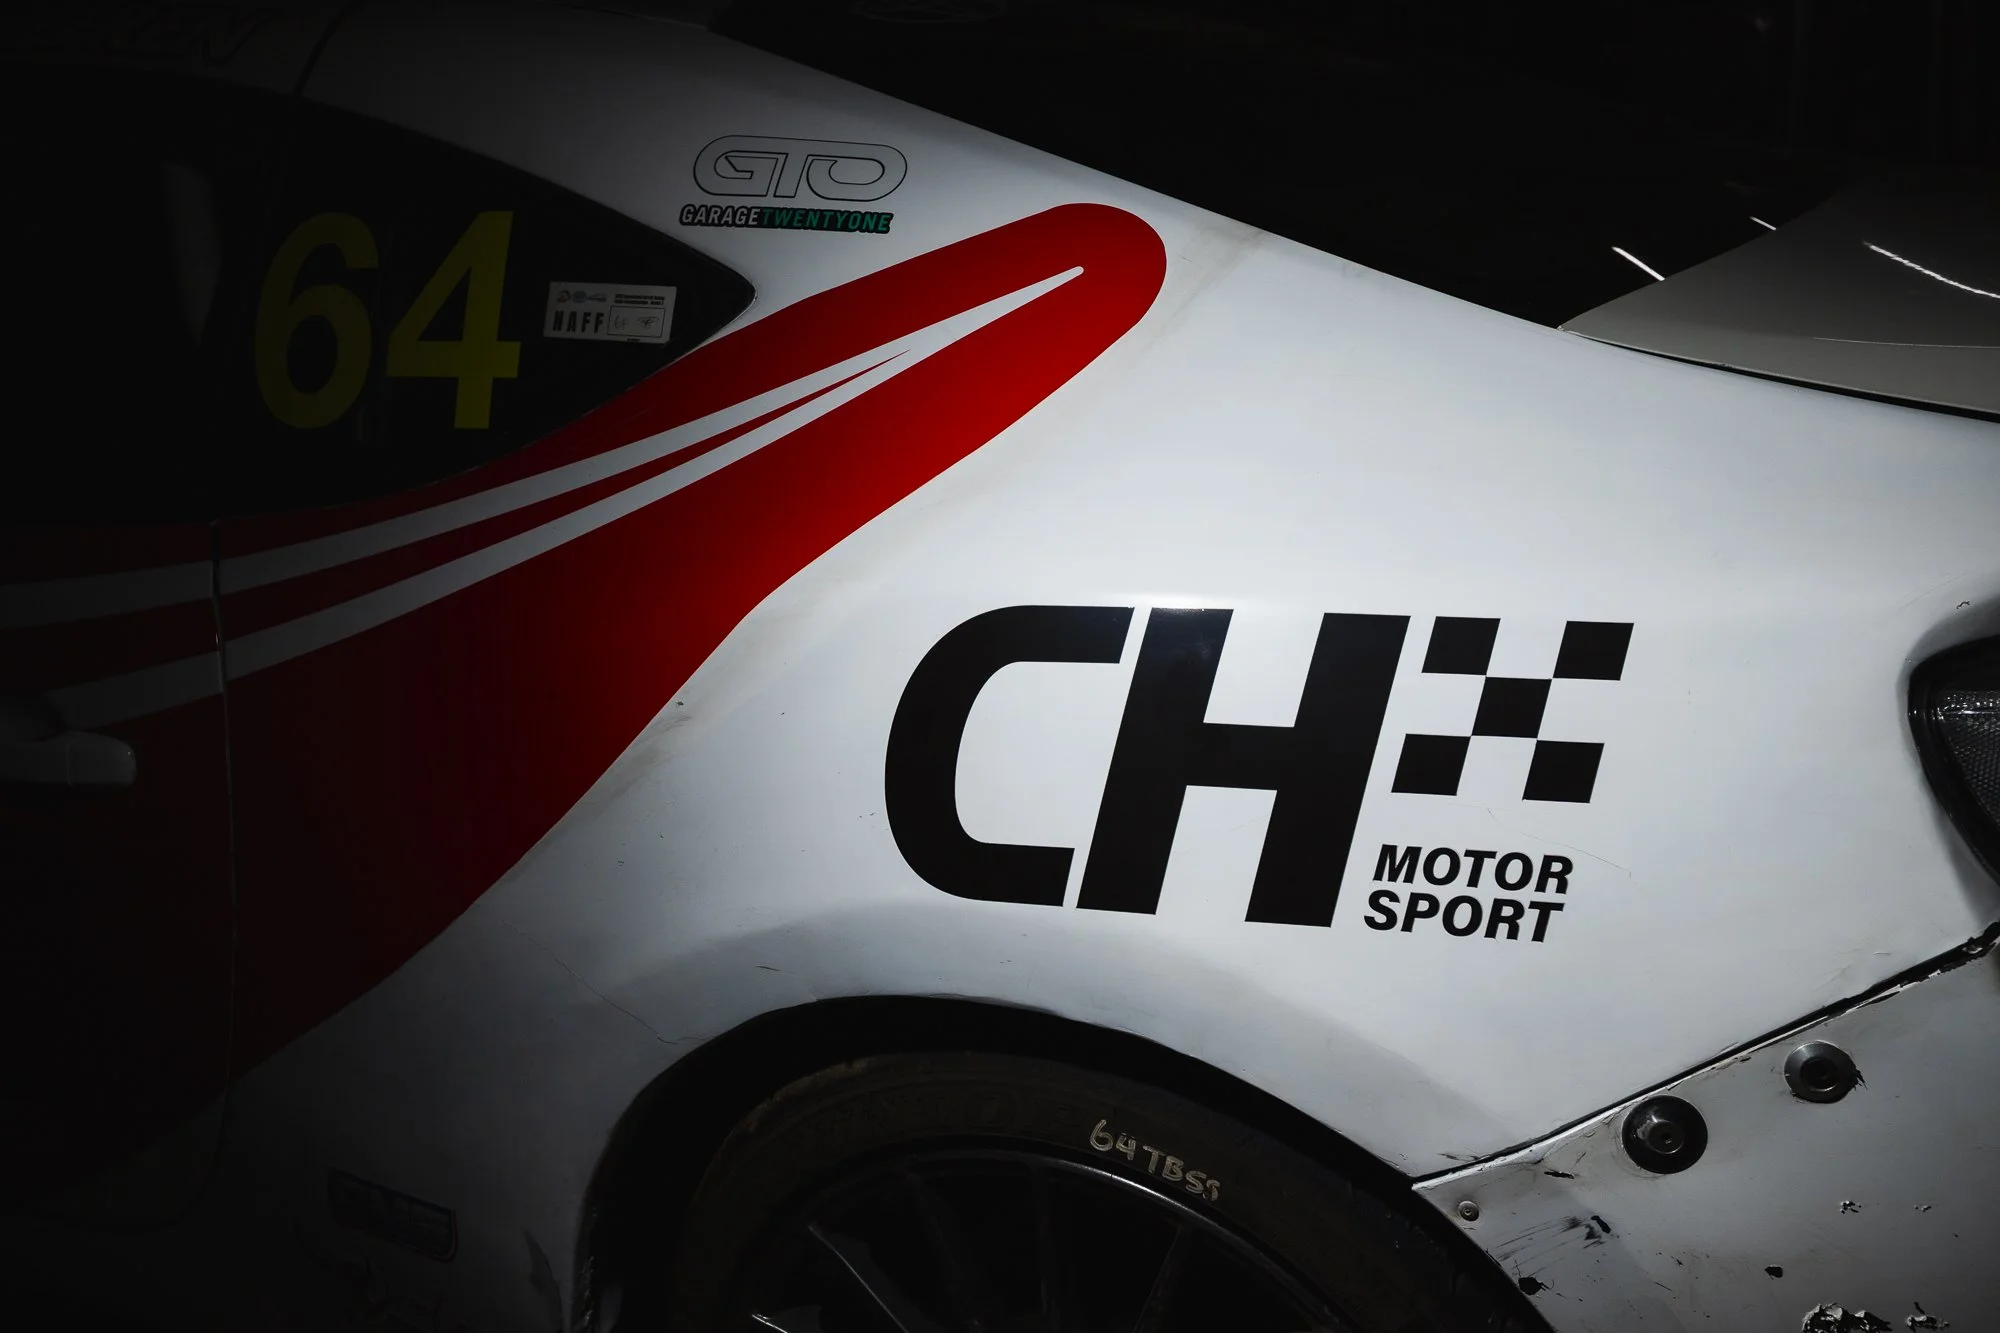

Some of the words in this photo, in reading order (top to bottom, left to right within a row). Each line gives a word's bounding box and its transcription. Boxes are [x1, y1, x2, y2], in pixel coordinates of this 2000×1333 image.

[255, 210, 522, 430] 64
[552, 310, 605, 333] NAFF
[885, 605, 1411, 928] CH
[1373, 844, 1573, 894] MOTOR
[1364, 890, 1566, 943] SPORT
